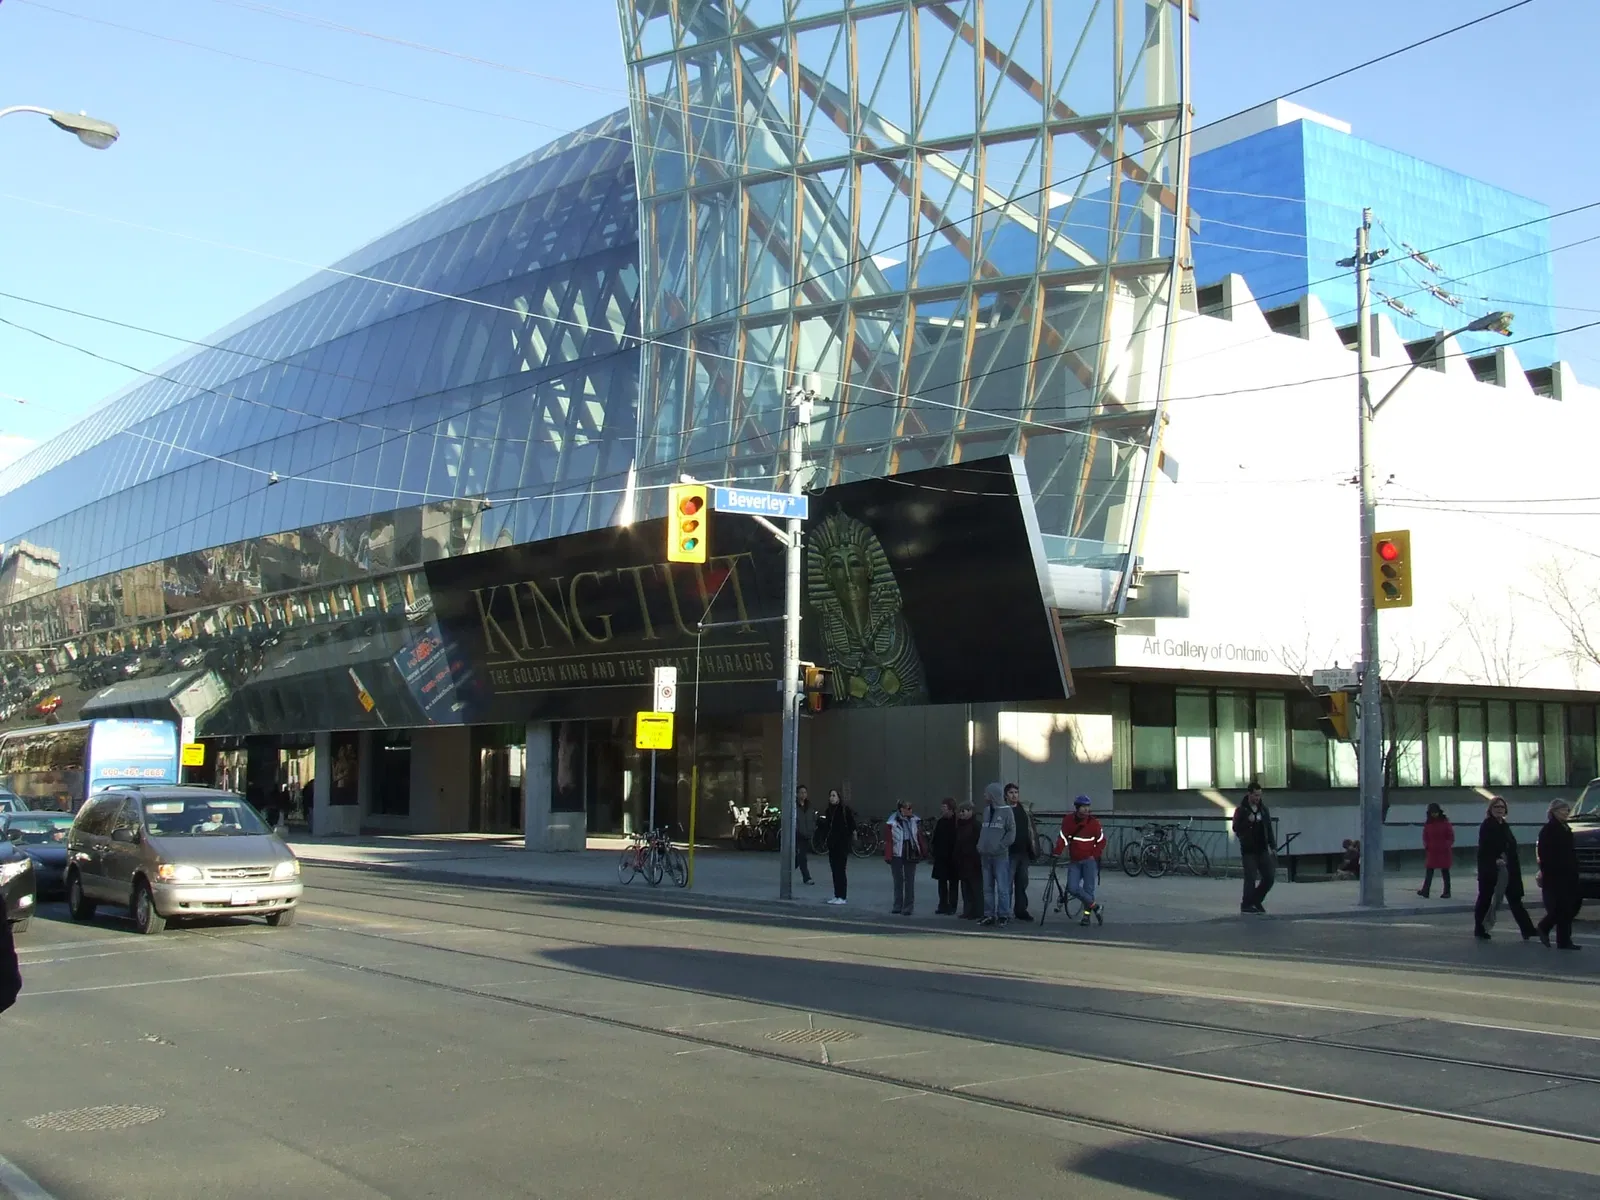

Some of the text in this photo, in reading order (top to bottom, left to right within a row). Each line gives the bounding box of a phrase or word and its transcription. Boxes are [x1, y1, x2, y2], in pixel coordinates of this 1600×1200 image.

[728, 490, 786, 514] Beverley
[469, 552, 756, 661] KING TUT
[1143, 637, 1268, 662] Art Gallery of Ontario
[489, 668, 509, 685] THE
[512, 665, 556, 685] GOLDEN
[559, 662, 587, 681] KING
[592, 661, 616, 678] AND
[620, 659, 645, 677] THE
